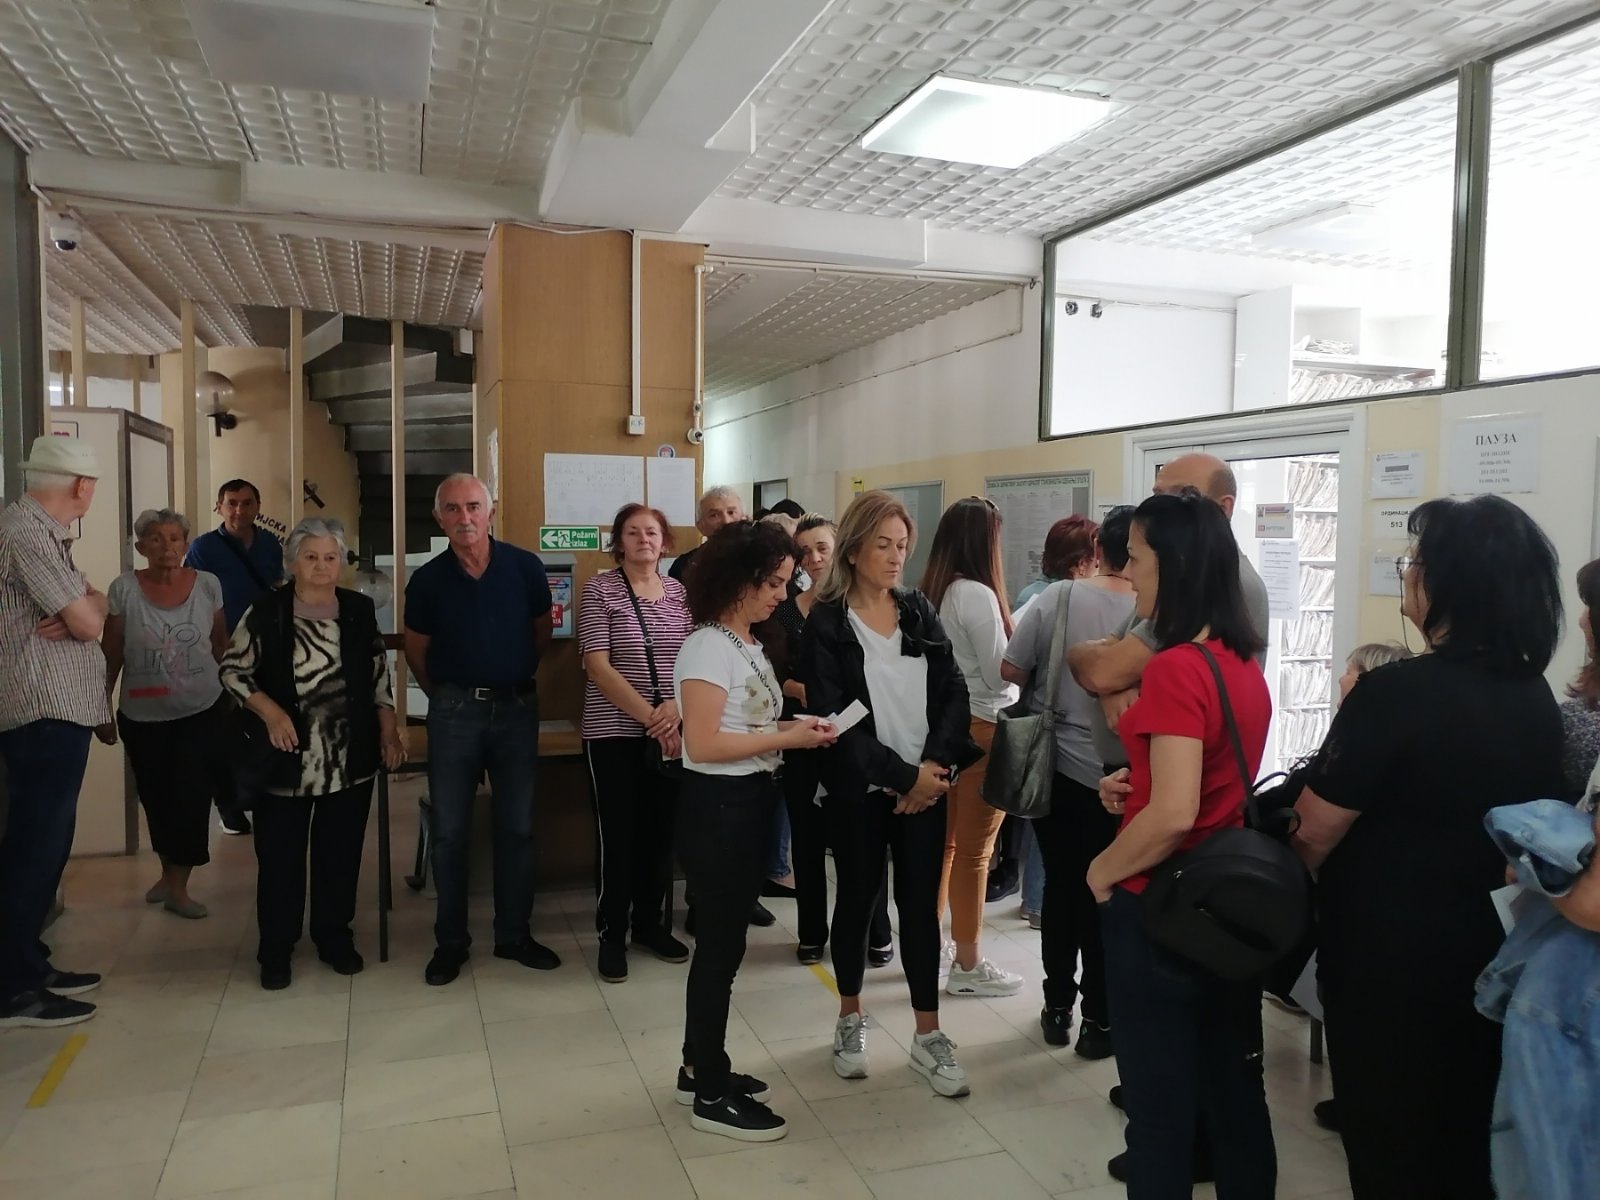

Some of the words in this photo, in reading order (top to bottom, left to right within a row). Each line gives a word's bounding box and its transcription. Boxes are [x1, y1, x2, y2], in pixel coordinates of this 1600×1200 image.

[1475, 433, 1517, 446] ПАУЗА
[571, 530, 598, 539] Požarni
[571, 540, 588, 548] izlaz
